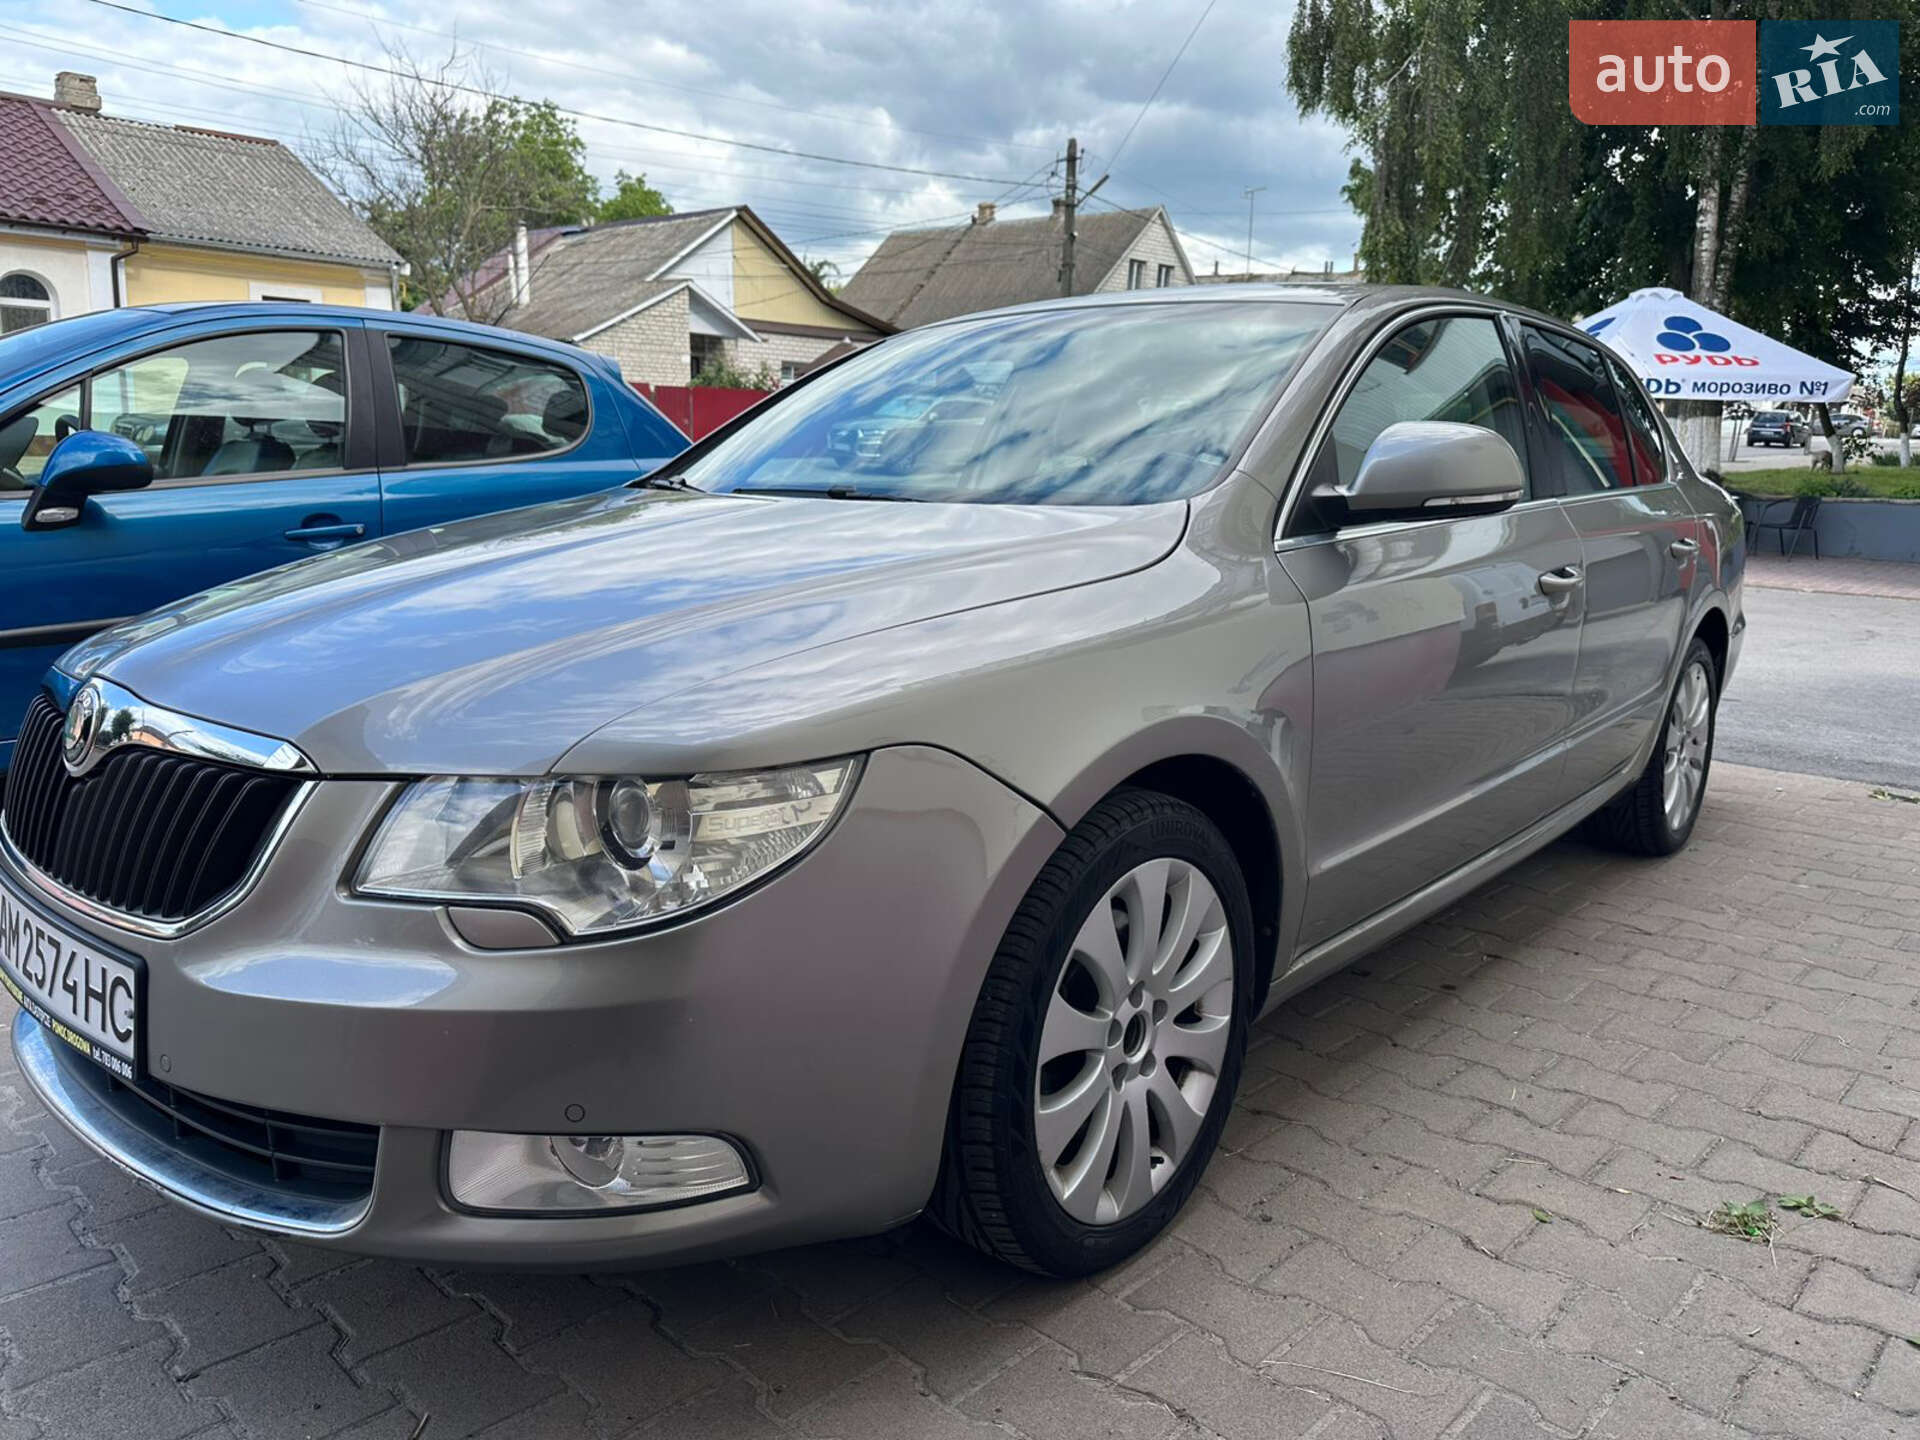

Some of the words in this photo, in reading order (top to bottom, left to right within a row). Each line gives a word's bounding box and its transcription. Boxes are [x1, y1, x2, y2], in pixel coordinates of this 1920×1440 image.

[1654, 353, 1759, 367] РУДЬ
[1641, 378, 1682, 395] ДЬ
[1692, 380, 1791, 396] морозиво
[1799, 381, 1829, 396] №1
